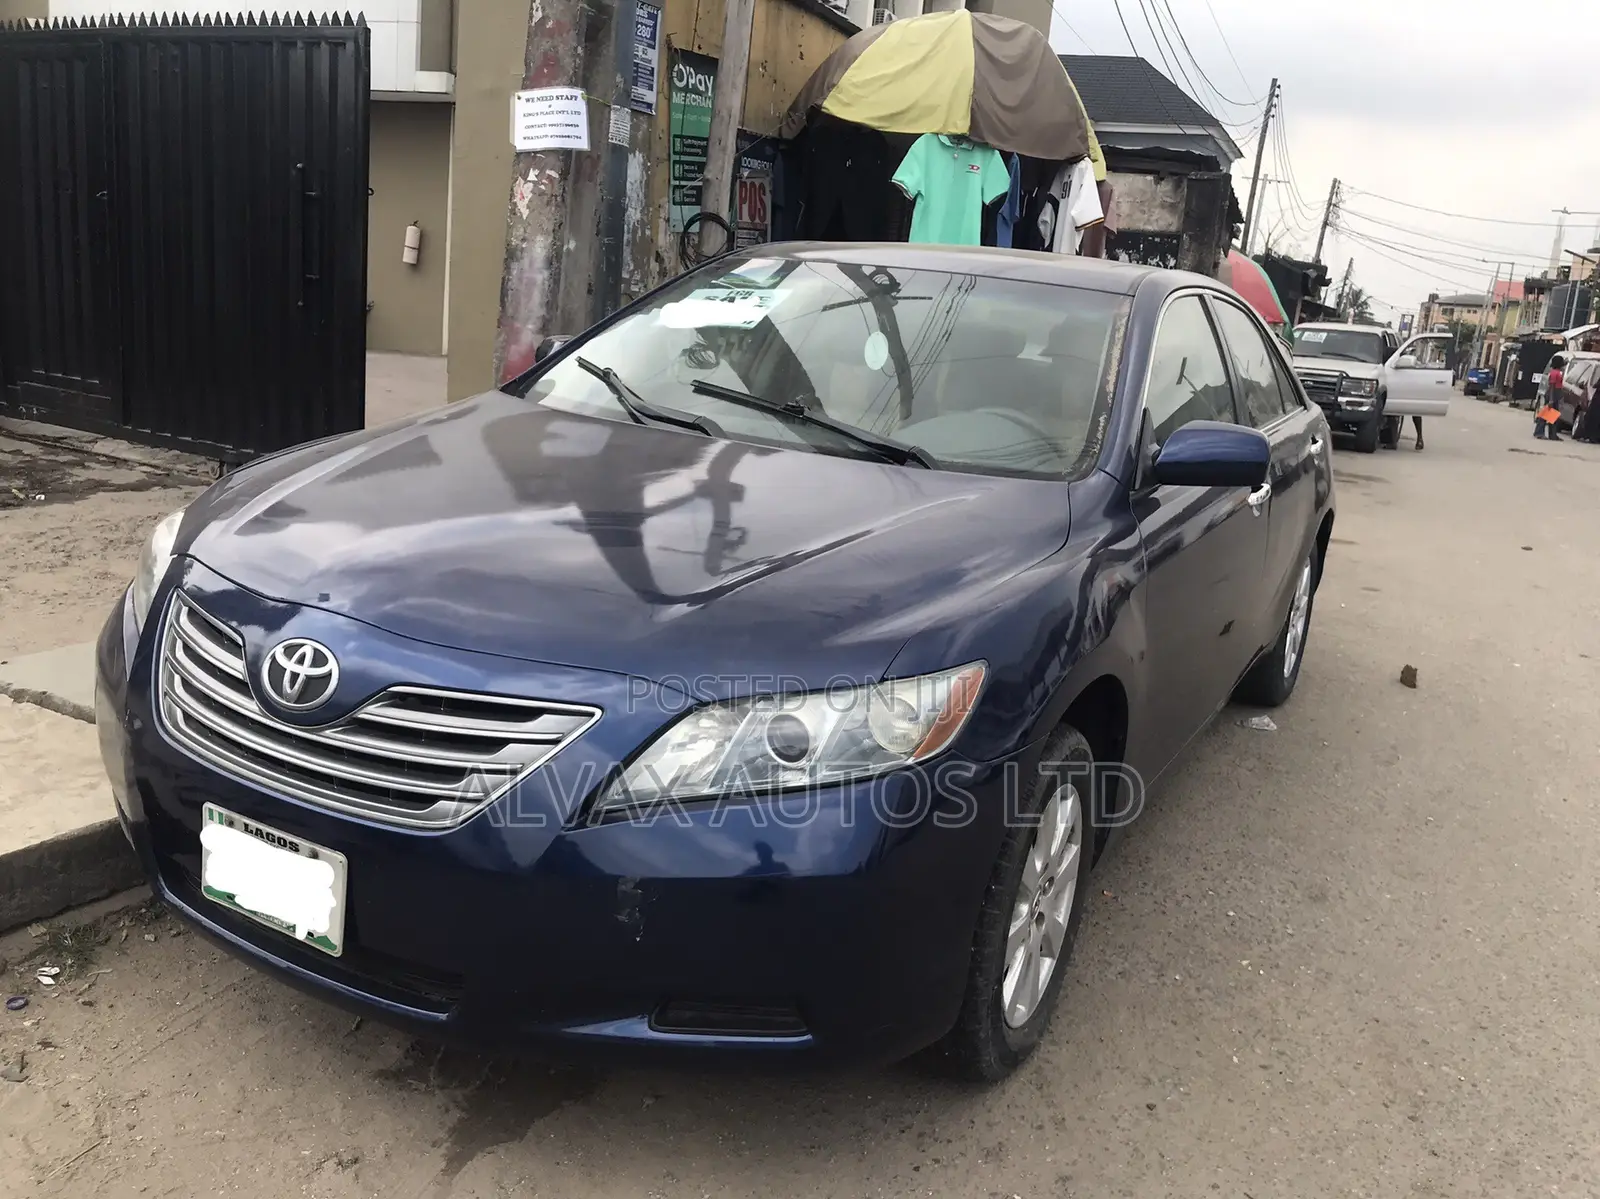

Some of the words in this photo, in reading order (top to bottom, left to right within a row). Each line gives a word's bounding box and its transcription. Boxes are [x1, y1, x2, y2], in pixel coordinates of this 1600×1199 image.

[555, 94, 579, 102] STAFF
[672, 91, 712, 108] MERCHAN
[739, 180, 767, 223] POS
[243, 822, 300, 853] LAGOS
